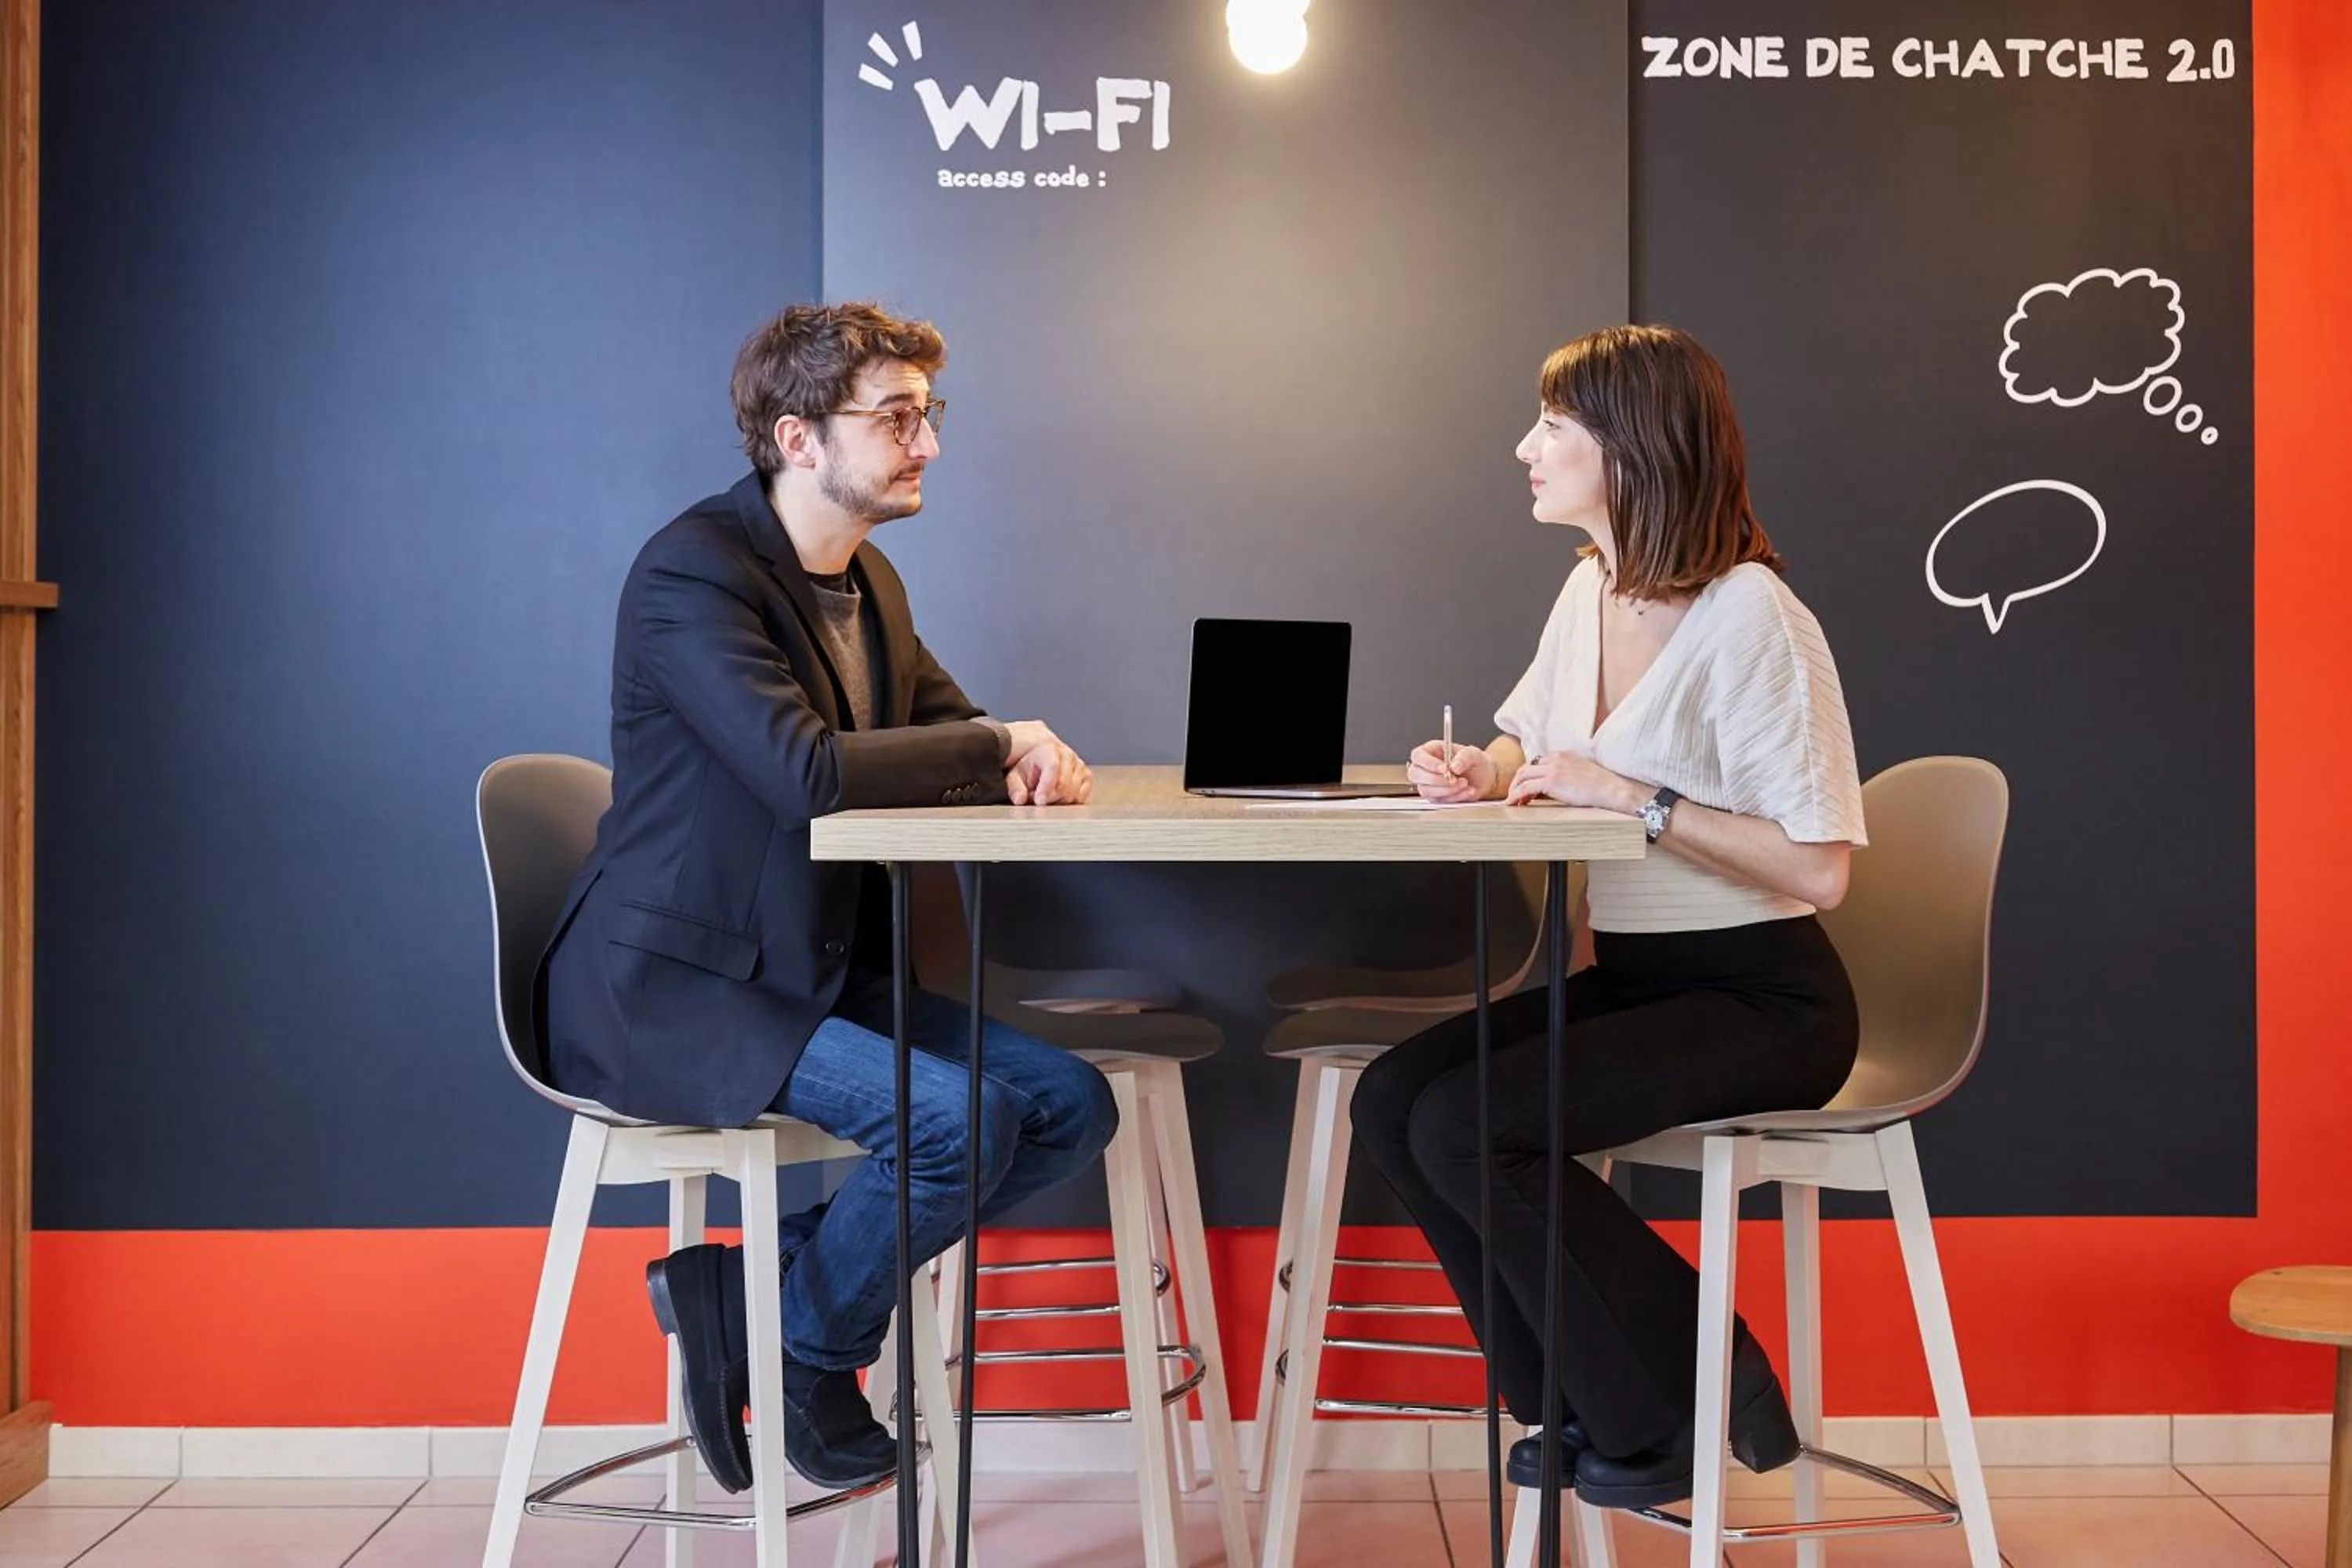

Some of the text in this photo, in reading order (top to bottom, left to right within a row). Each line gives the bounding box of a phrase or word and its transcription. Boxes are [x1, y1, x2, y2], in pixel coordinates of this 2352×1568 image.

[1641, 36, 2236, 82] ZONE DE CHATCHE 2.0
[913, 76, 1171, 152] WI-FI
[937, 169, 1026, 188] access
[1033, 164, 1091, 187] code
